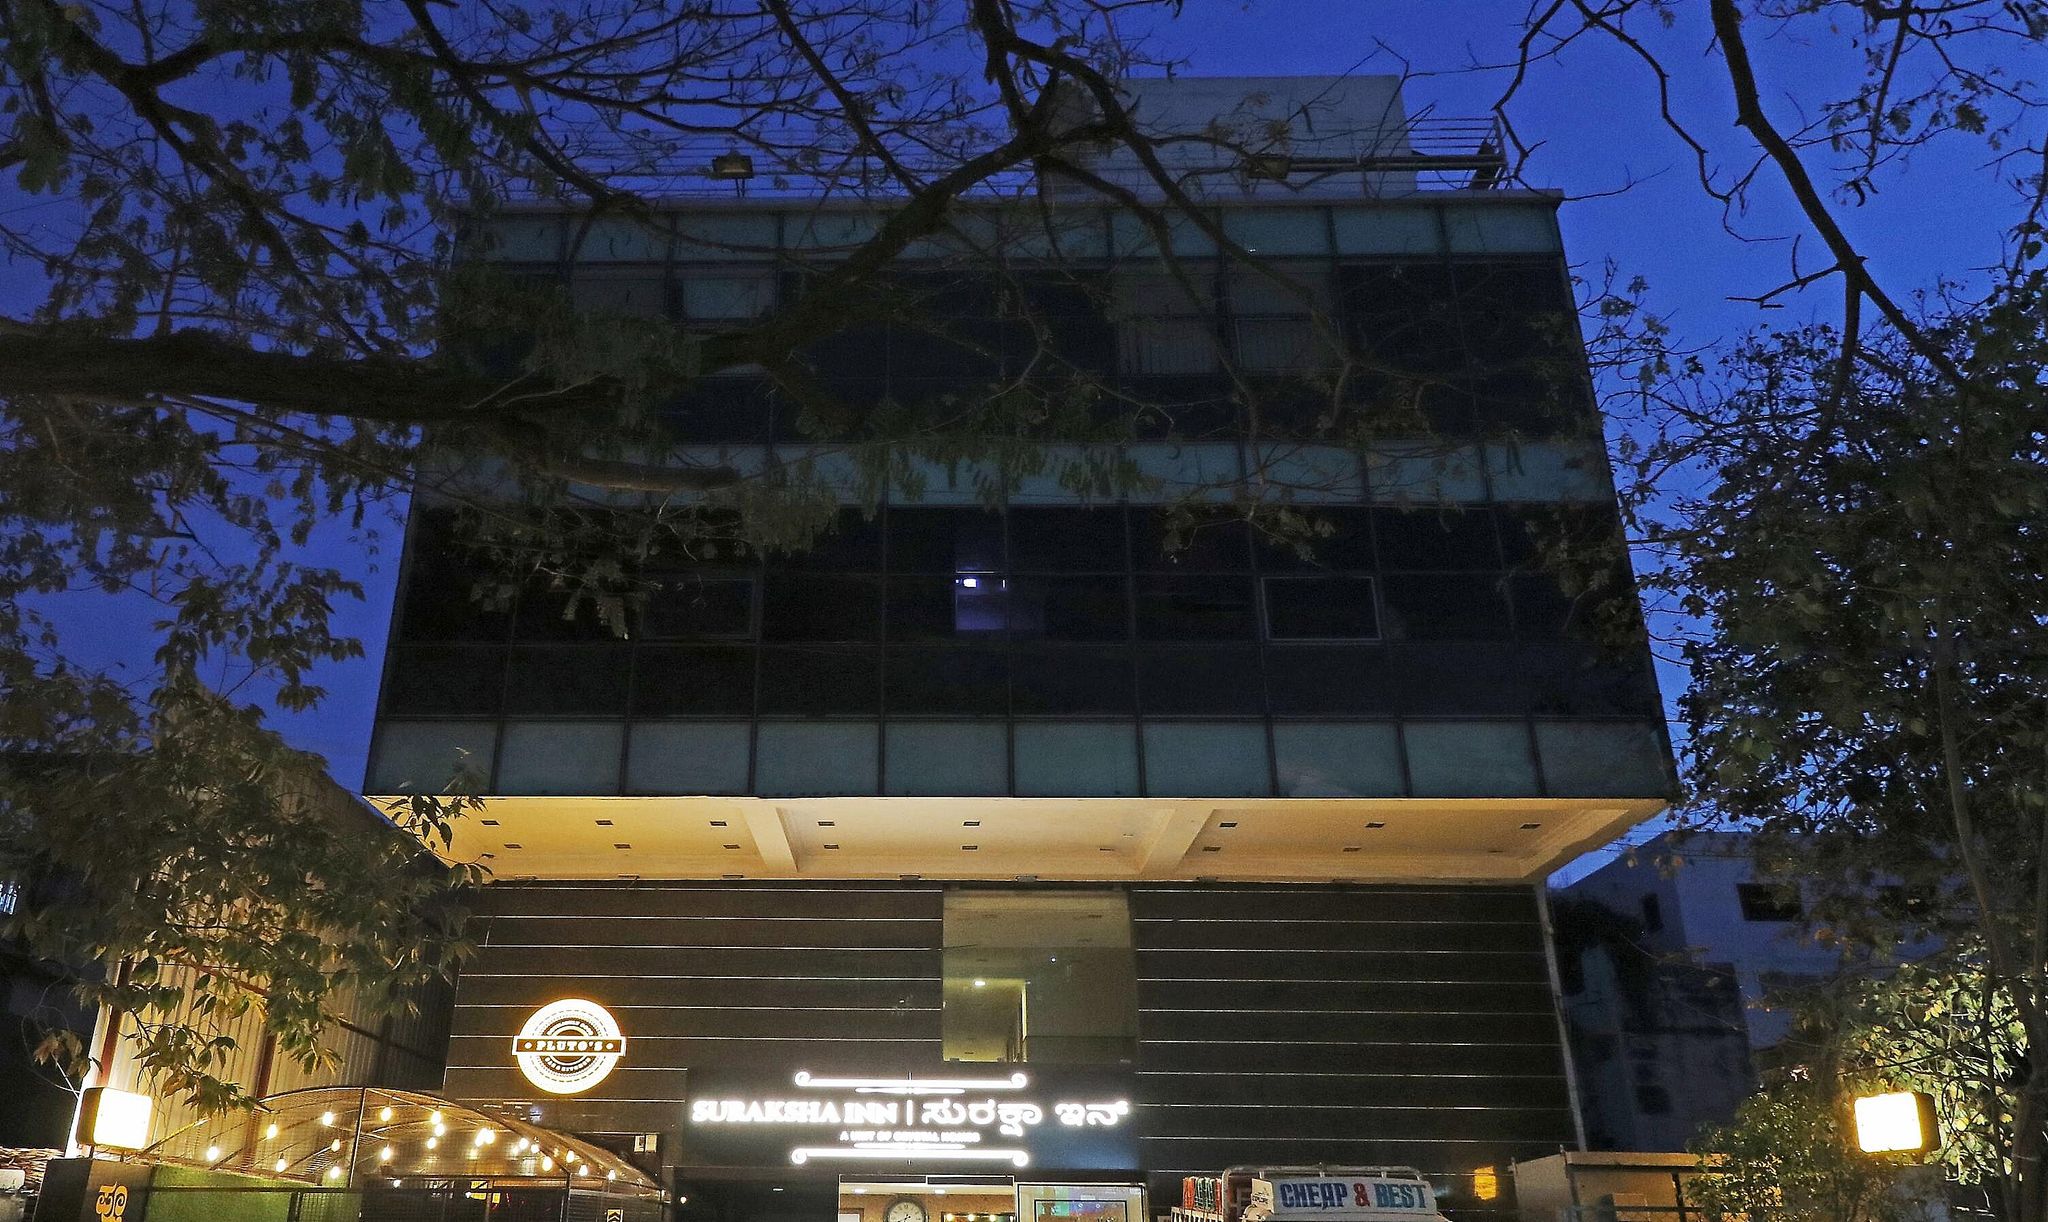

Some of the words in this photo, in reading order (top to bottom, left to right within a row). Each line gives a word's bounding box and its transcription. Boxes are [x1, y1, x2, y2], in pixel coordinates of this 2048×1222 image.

[536, 1040, 603, 1051] PLUTO'S
[692, 1100, 841, 1122] SURAKSHA
[844, 1102, 898, 1124] INN
[921, 1098, 1043, 1137] ಸುರಕ್ಷಾ
[1054, 1100, 1129, 1126] ಇನ್
[1280, 1183, 1348, 1209] CHEAP
[1353, 1183, 1371, 1207] &
[1373, 1184, 1427, 1208] BEST
